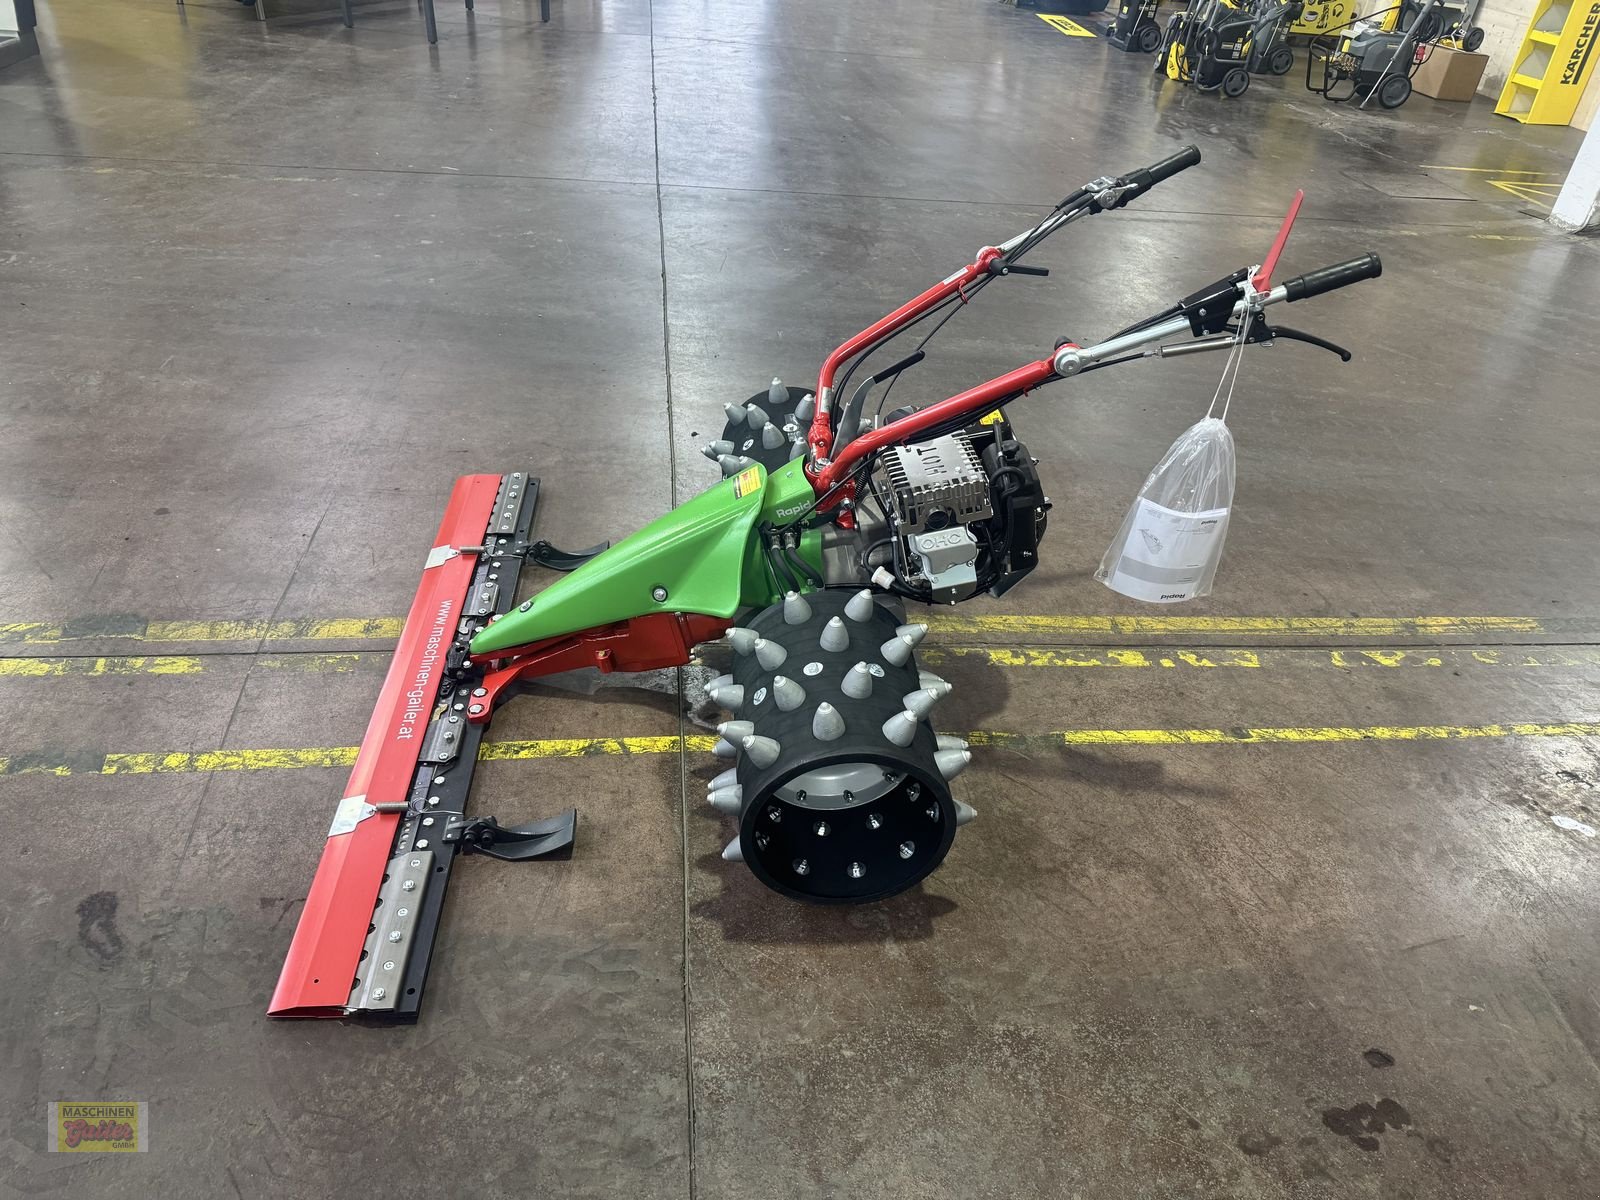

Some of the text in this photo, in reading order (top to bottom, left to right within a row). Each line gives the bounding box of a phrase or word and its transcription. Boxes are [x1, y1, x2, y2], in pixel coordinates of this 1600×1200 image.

[1560, 3, 1600, 85] KÄRCHER
[916, 448, 947, 475] HOT
[776, 501, 812, 518] Rapid
[397, 600, 453, 740] www.maschinen-gailer.at
